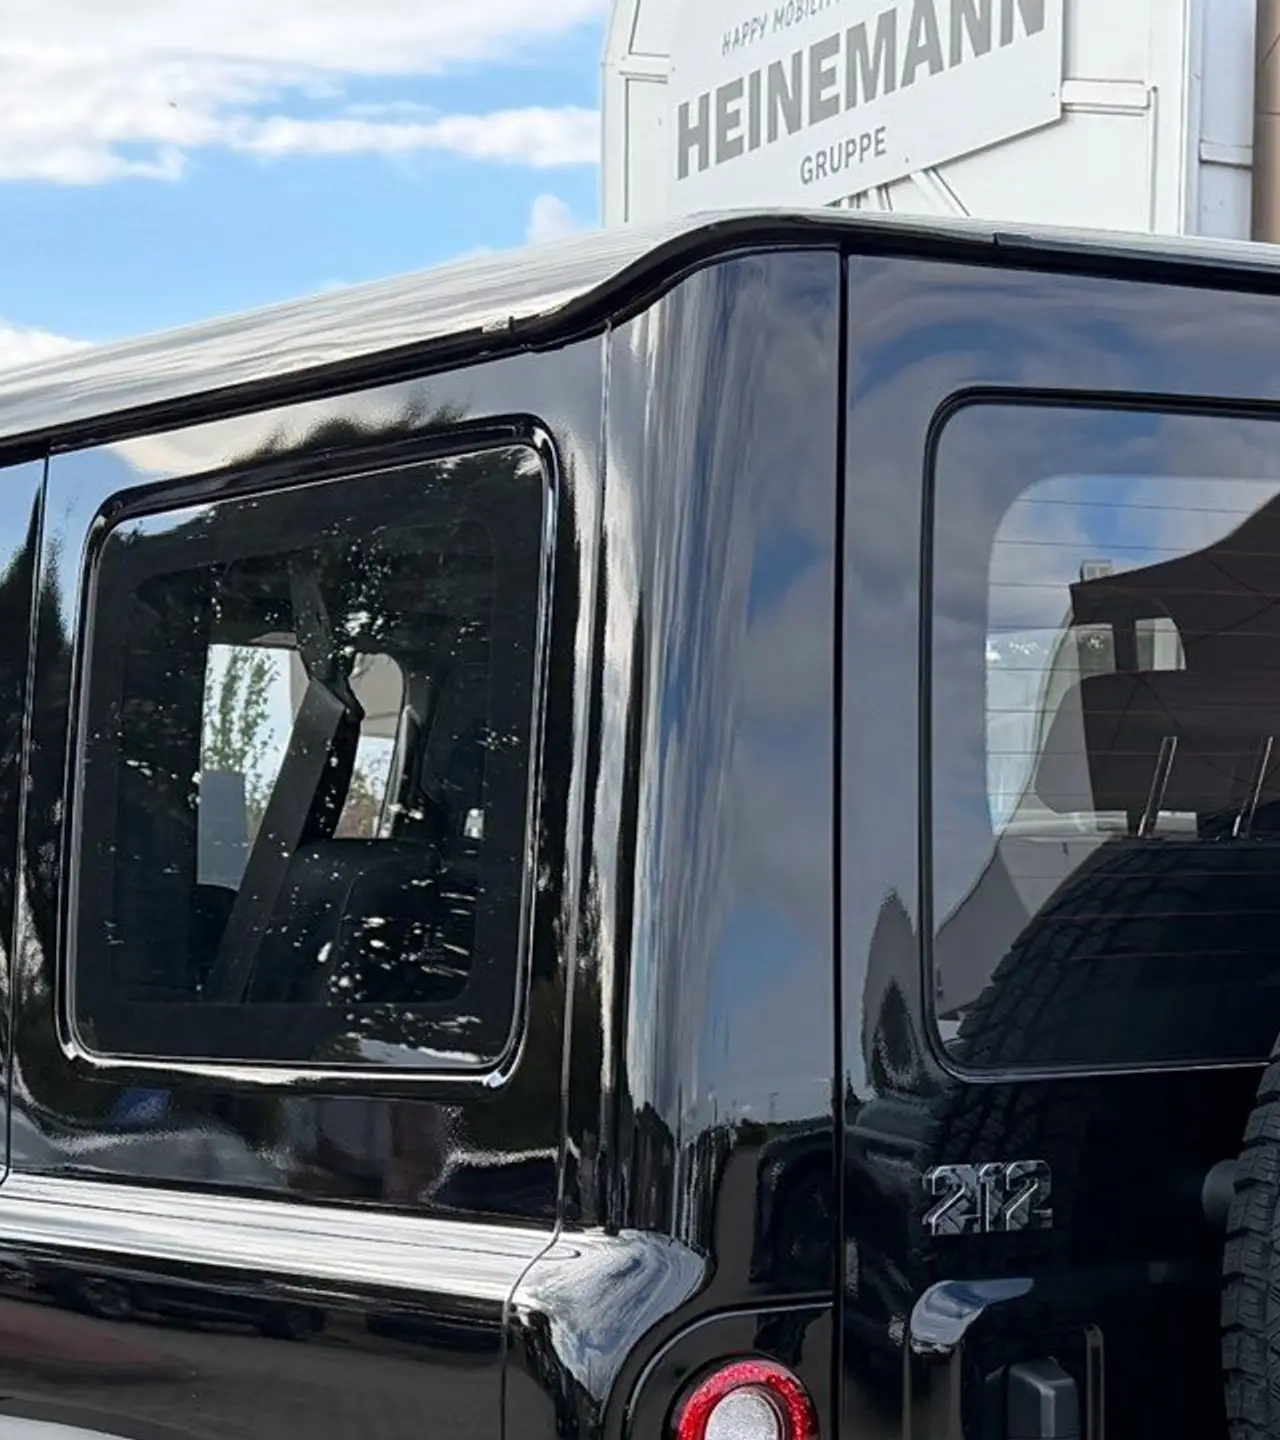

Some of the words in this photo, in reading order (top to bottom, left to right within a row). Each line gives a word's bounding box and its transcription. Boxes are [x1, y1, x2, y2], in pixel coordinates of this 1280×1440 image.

[721, 12, 768, 58] HAPPY
[800, 126, 887, 185] GRUPPE
[924, 1160, 1054, 1236] 212
